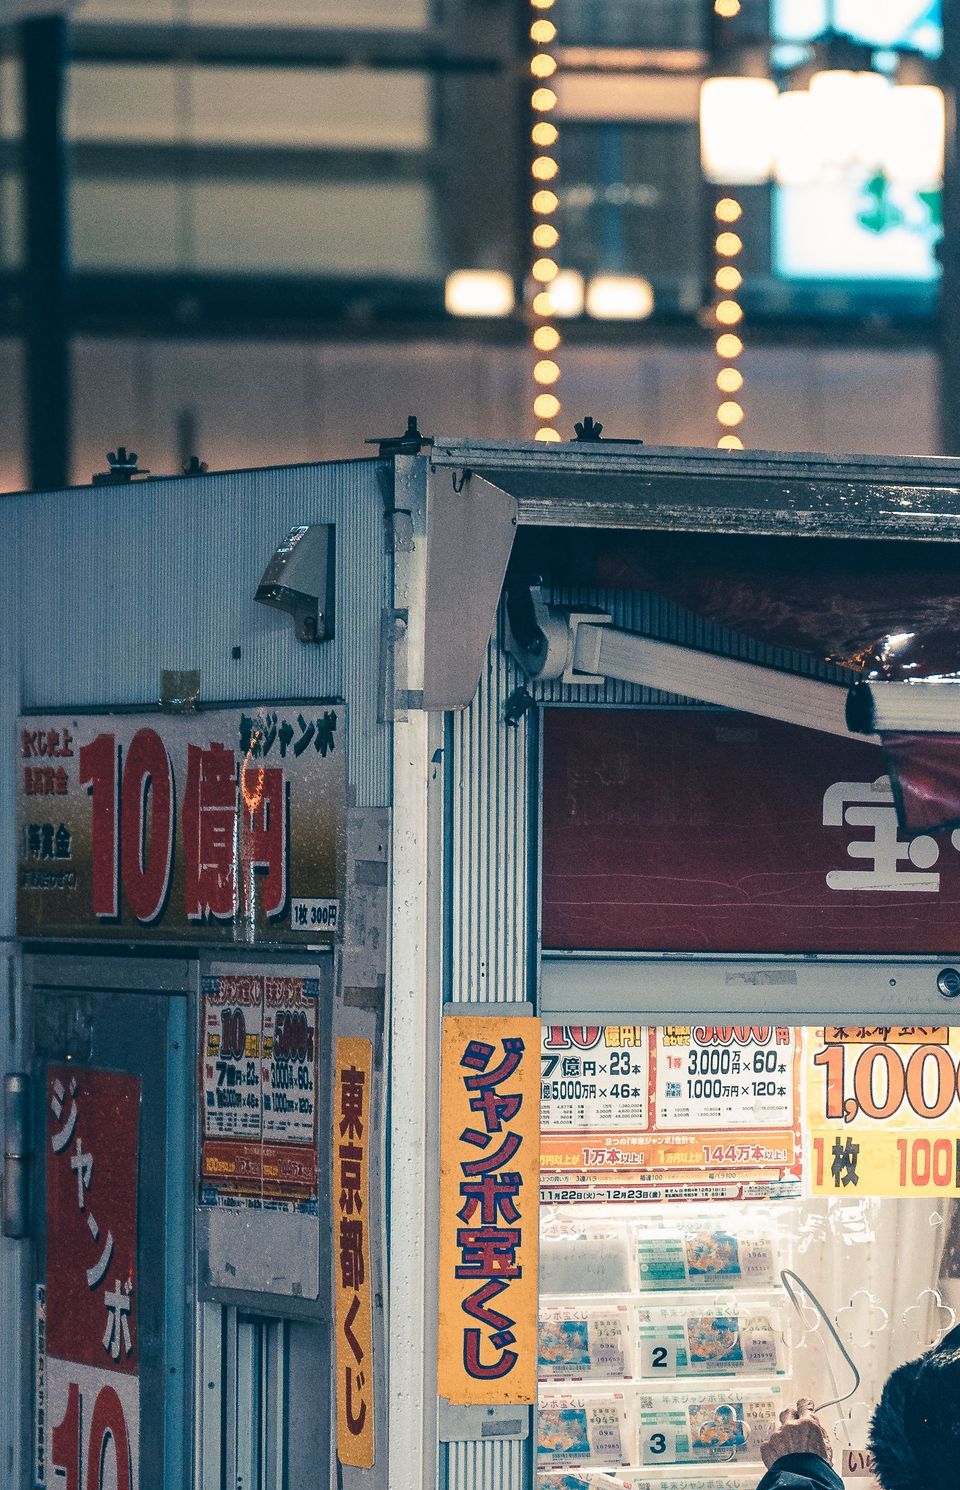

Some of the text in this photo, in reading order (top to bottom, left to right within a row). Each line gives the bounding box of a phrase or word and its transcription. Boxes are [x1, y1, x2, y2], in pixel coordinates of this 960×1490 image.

[51, 1077, 133, 1361] ジャンボ
[455, 1037, 526, 1381] ジャンボ宝くじ
[813, 1136, 860, 1188] 1枚
[338, 1065, 367, 1437] 東京都くじ
[651, 1346, 668, 1368] 2
[649, 1433, 667, 1454] 3
